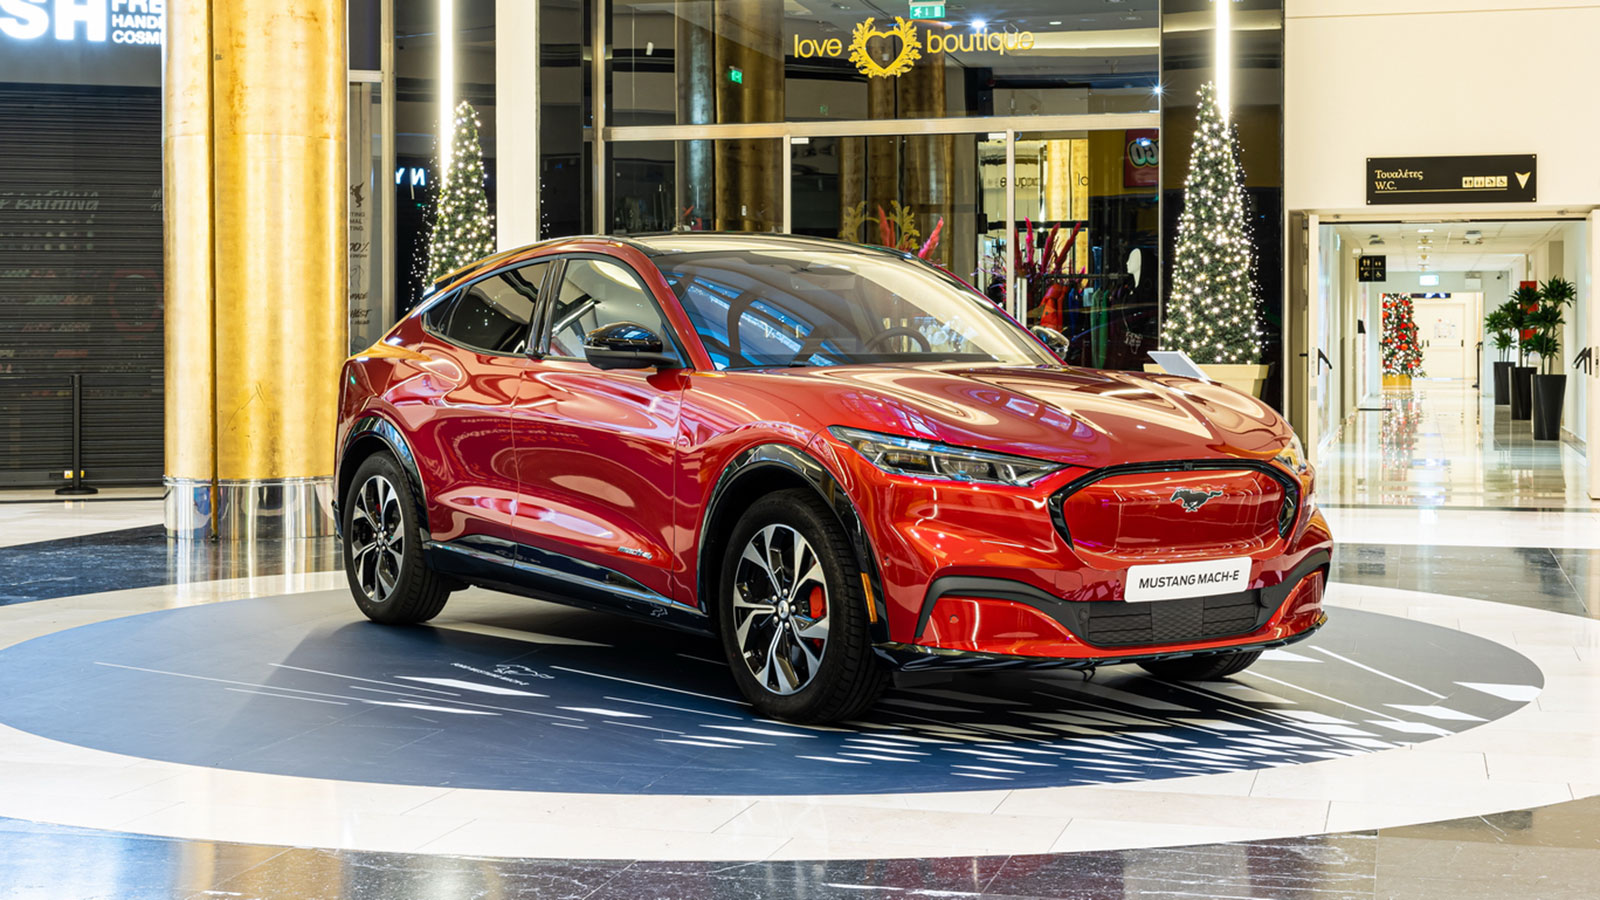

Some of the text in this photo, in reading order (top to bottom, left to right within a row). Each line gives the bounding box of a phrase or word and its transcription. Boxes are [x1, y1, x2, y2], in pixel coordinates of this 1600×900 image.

[112, 14, 161, 29] HAND
[794, 28, 1034, 58] love boutique
[1375, 169, 1423, 180] Τουαλέτες
[1375, 181, 1397, 190] W.C.
[1139, 570, 1240, 589] MUSTANG MACH-E
